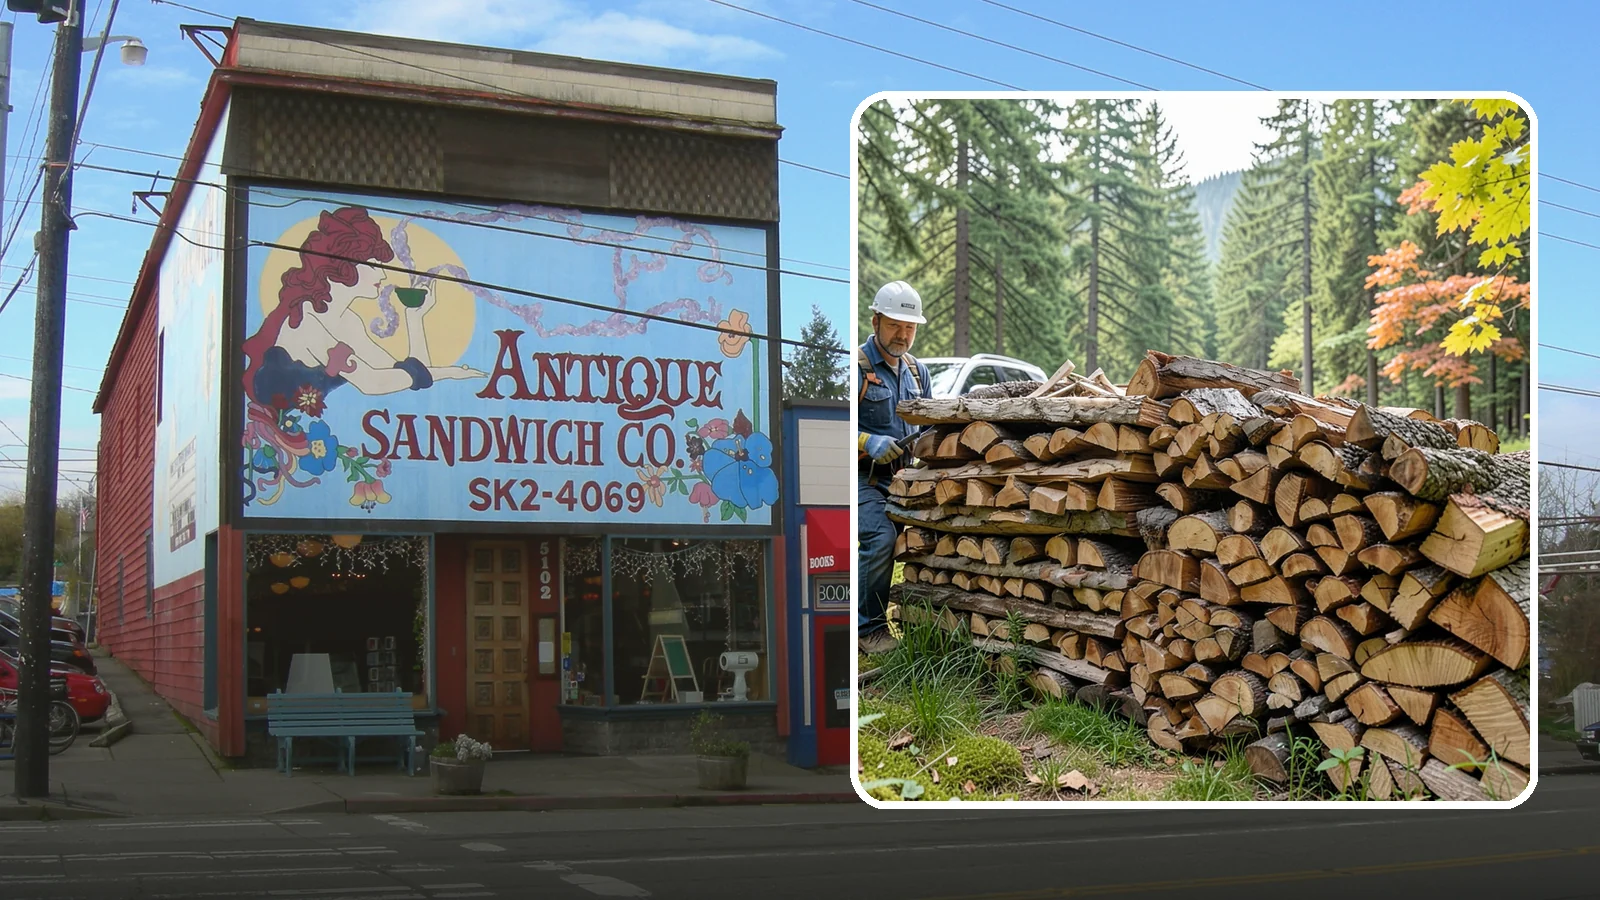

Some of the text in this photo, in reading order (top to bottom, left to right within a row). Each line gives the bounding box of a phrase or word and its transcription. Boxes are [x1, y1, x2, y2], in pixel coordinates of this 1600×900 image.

[475, 329, 723, 420] ANTIQUE
[361, 408, 685, 468] SANDWICH CO.
[468, 477, 646, 513] SK2-4069
[540, 541, 551, 600] 5102
[809, 555, 835, 569] BOOKS
